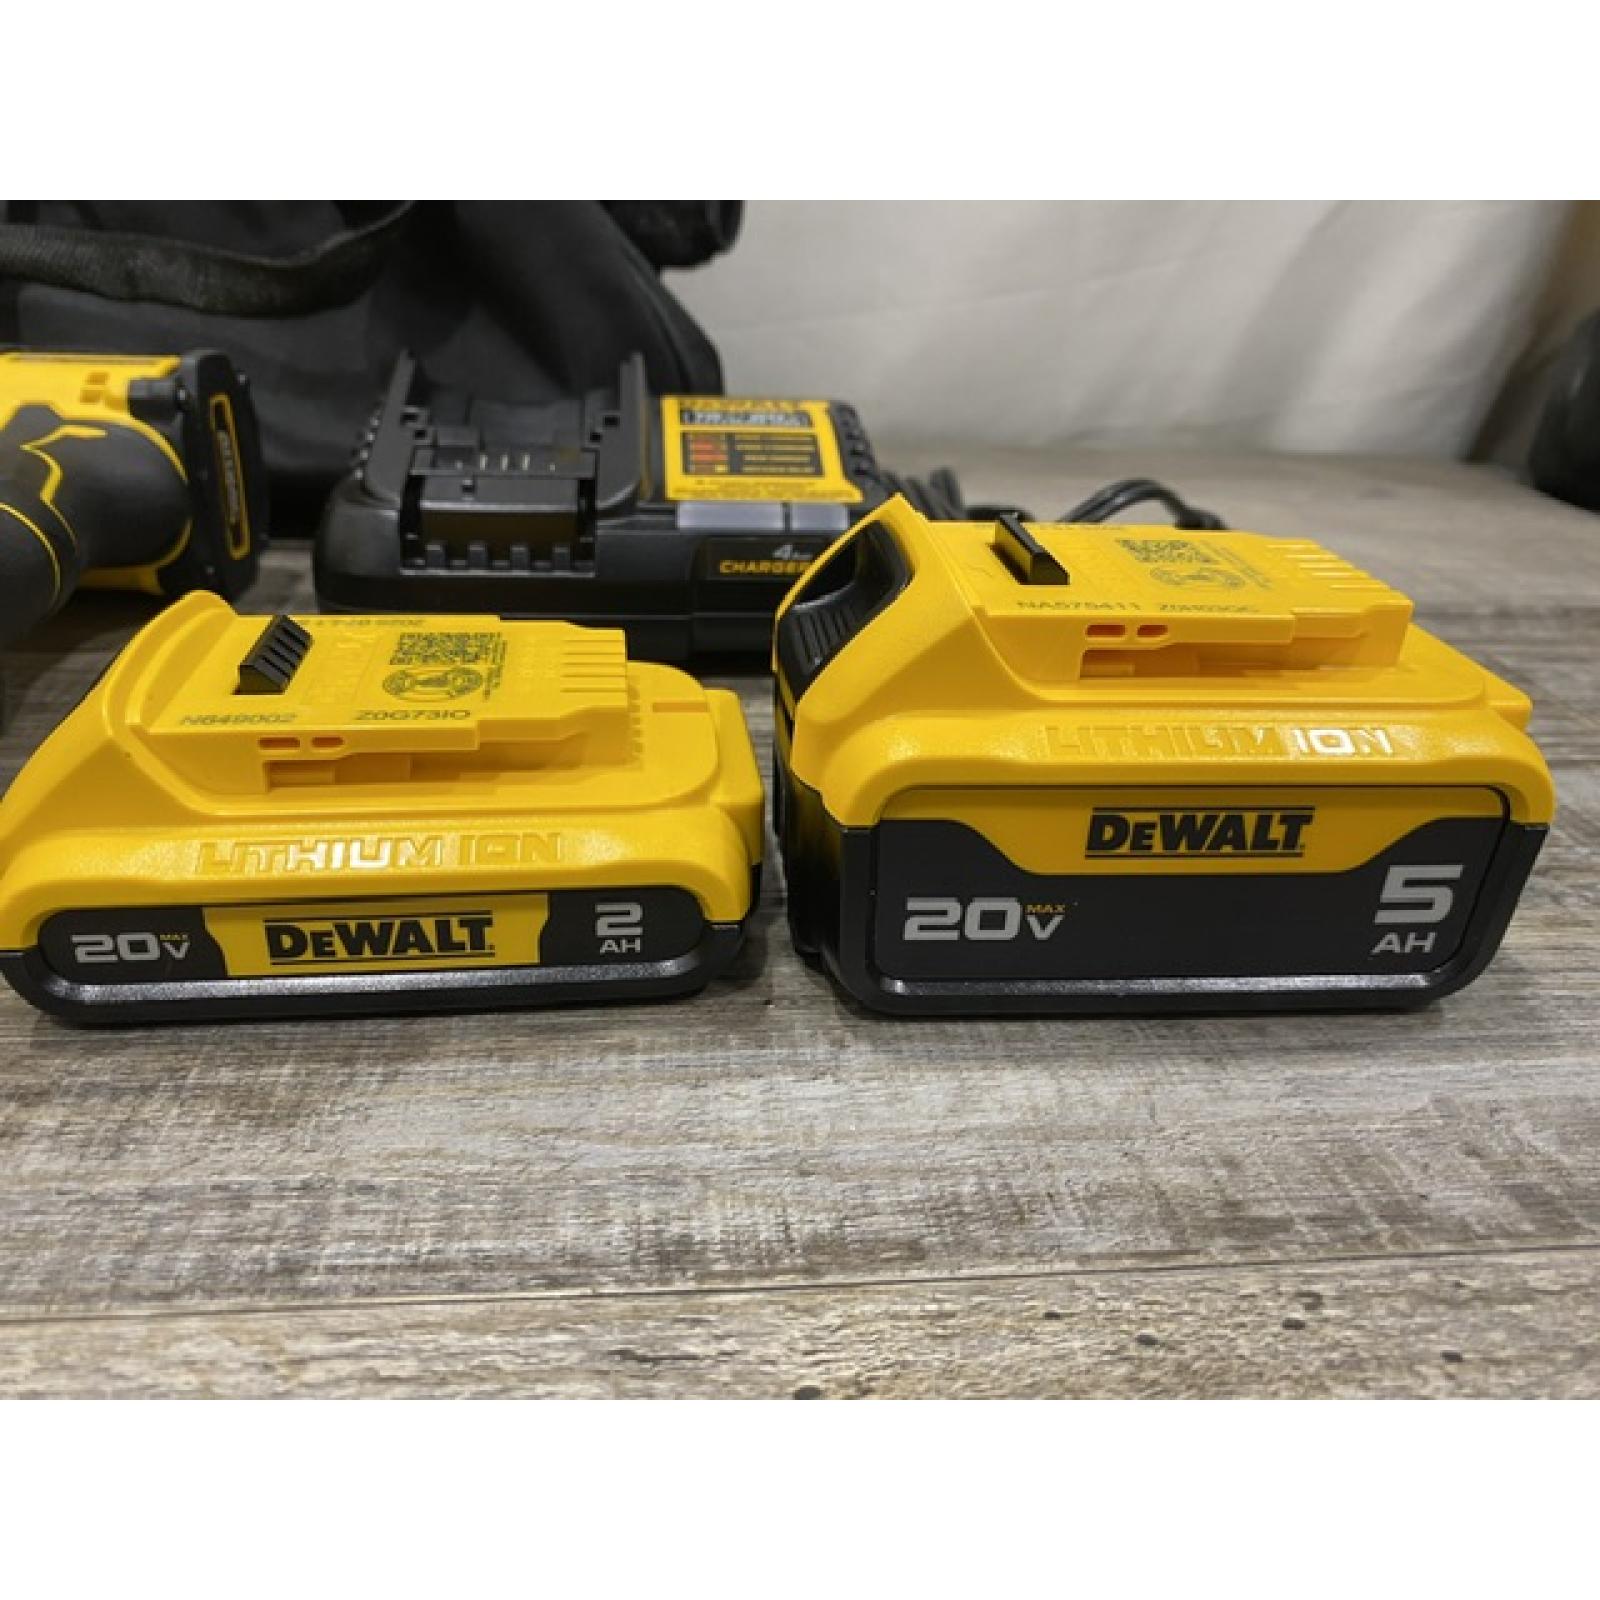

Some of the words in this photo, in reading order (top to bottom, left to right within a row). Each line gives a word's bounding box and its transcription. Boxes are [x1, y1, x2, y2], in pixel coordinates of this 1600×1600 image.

[1043, 725, 1280, 758] LITHIUM
[1288, 726, 1394, 755] ION
[194, 836, 442, 874] LITHIUM
[458, 832, 562, 866] ION
[1374, 864, 1464, 925] 5
[595, 902, 644, 937] 2
[600, 938, 641, 954] AH
[1370, 931, 1437, 954] AH
